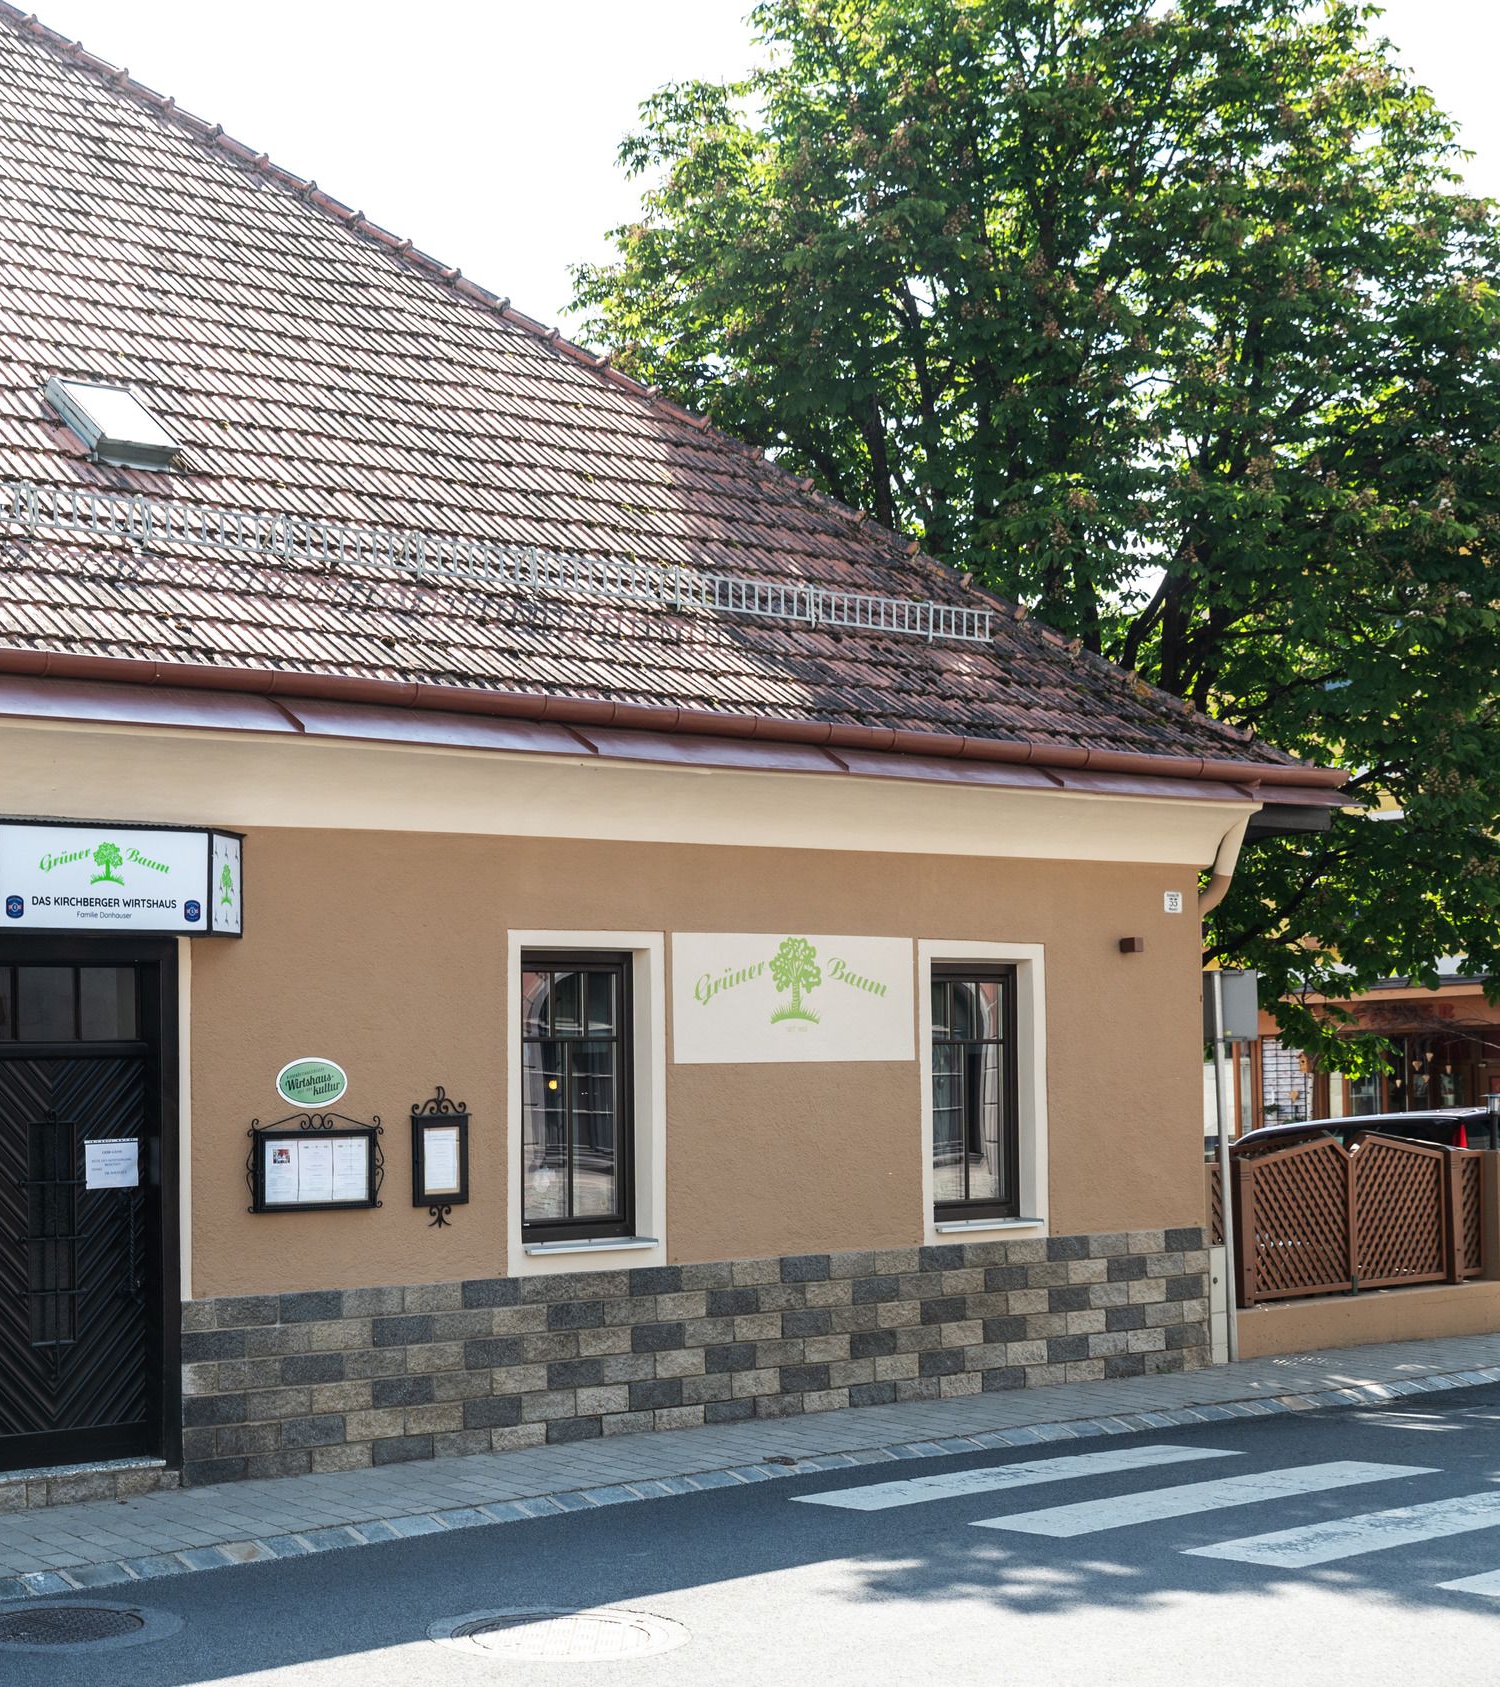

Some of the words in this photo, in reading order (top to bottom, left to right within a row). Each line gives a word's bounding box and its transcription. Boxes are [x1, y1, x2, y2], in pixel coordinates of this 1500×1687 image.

[39, 848, 91, 873] Grüner
[126, 848, 171, 874] Baum
[31, 896, 51, 906] DAS
[53, 896, 120, 908] KIRCHBERGER
[121, 898, 177, 909] WIRTSHAUS
[76, 911, 99, 919] Familie
[694, 959, 766, 1006] Grüner
[827, 957, 888, 998] Baum
[313, 1082, 340, 1096] kultur
